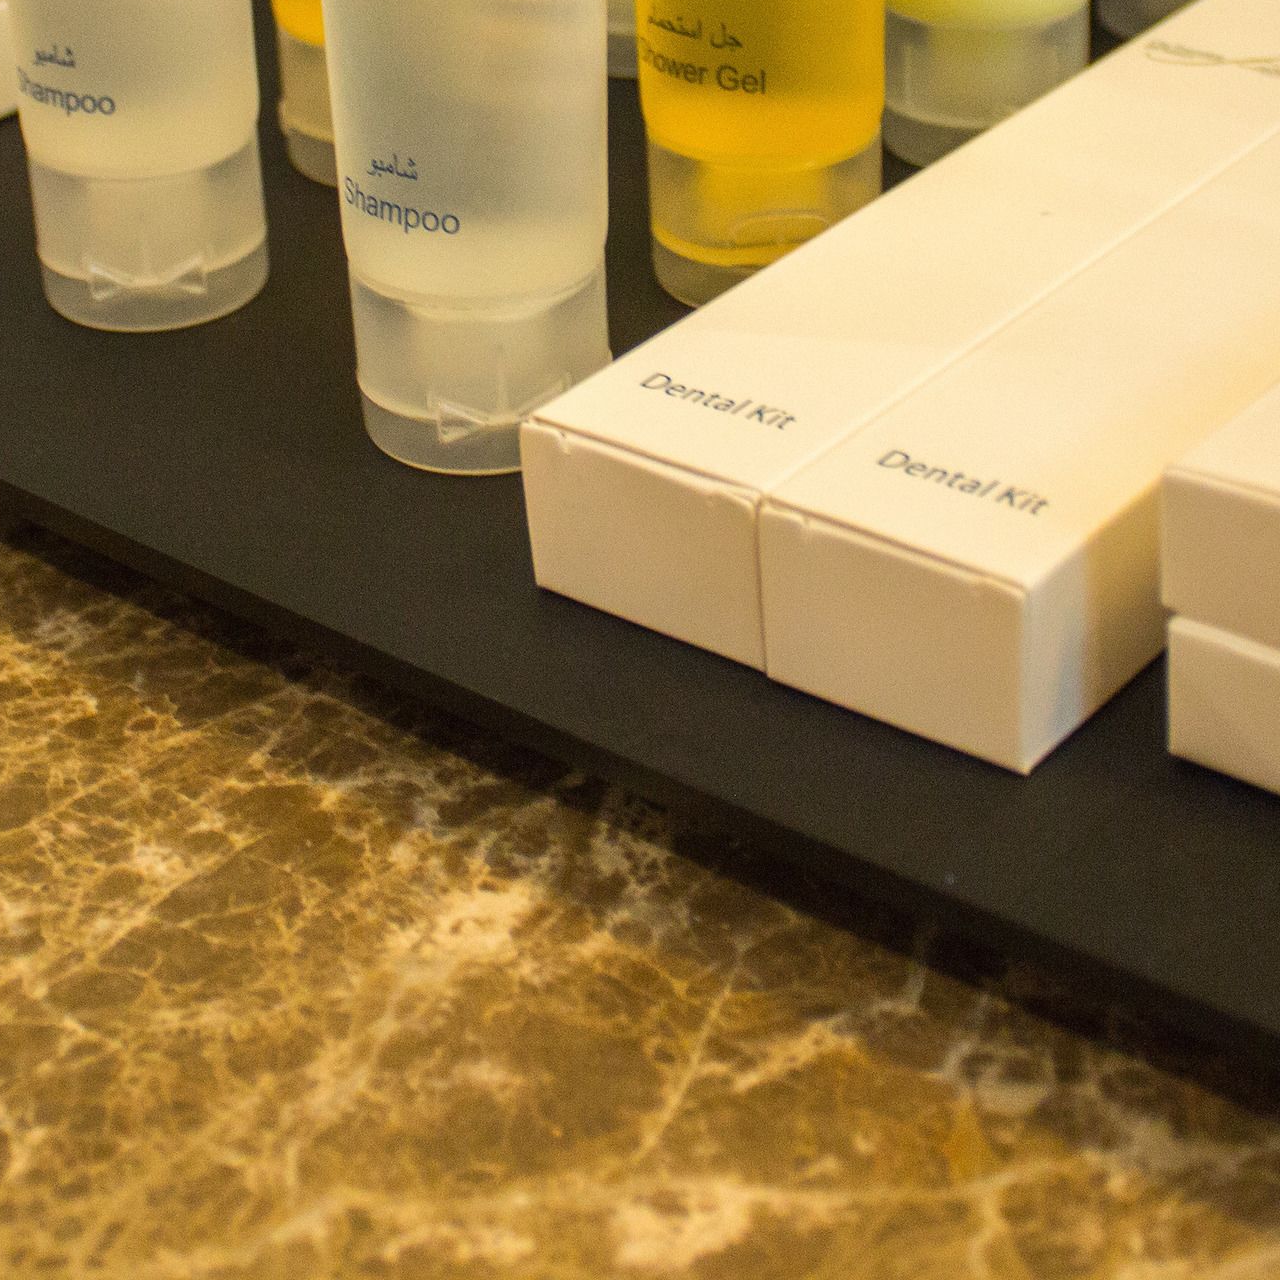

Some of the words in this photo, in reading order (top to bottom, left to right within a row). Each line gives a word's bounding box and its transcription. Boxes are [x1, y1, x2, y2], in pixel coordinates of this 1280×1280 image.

[716, 64, 767, 95] Gel
[344, 175, 460, 235] Shampoo
[640, 372, 753, 415] Dental
[745, 404, 797, 430] Kit
[877, 449, 1000, 498] Dental
[995, 486, 1049, 515] Kit
